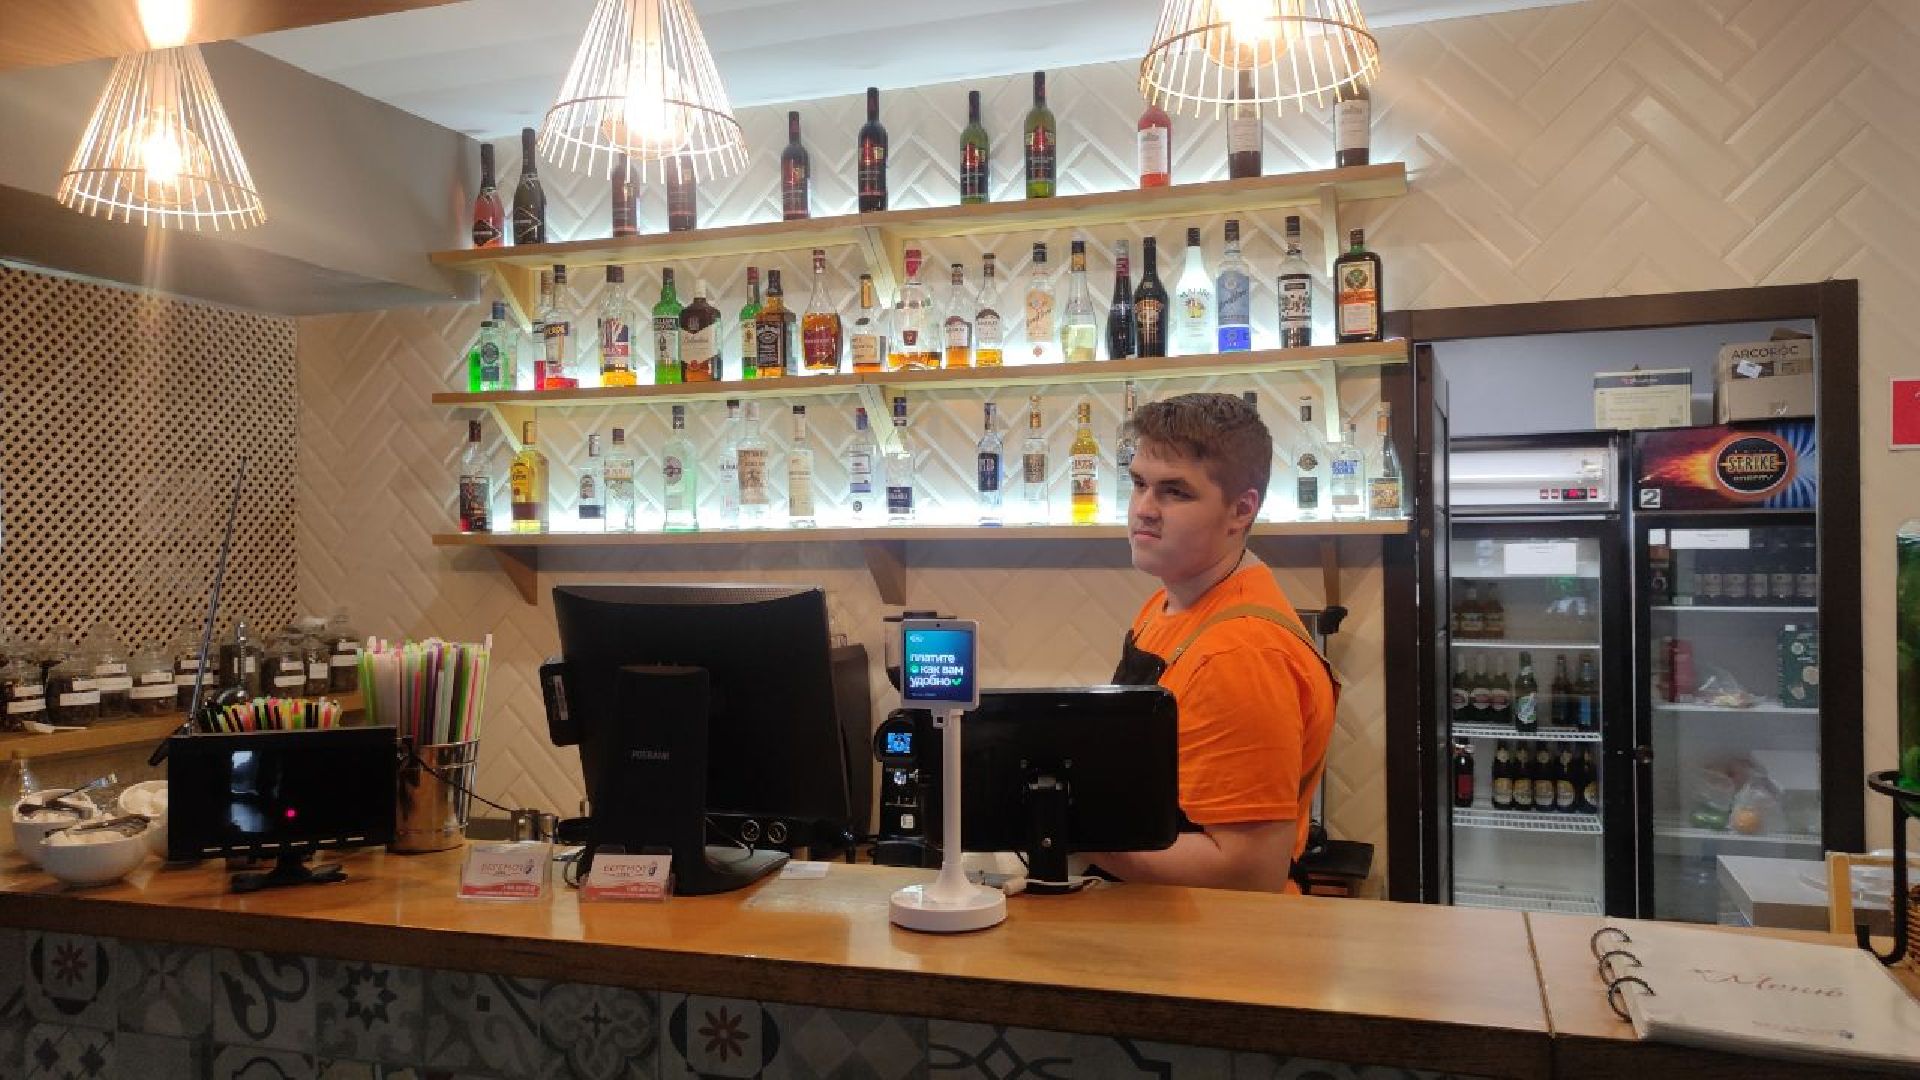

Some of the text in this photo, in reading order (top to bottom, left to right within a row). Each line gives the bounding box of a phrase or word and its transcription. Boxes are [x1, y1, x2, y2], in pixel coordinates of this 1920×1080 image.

[1727, 453, 1777, 472] STRIKE
[1643, 491, 1659, 506] 2
[909, 653, 956, 664] платите
[920, 665, 964, 676] как вам
[909, 674, 952, 688] удобно
